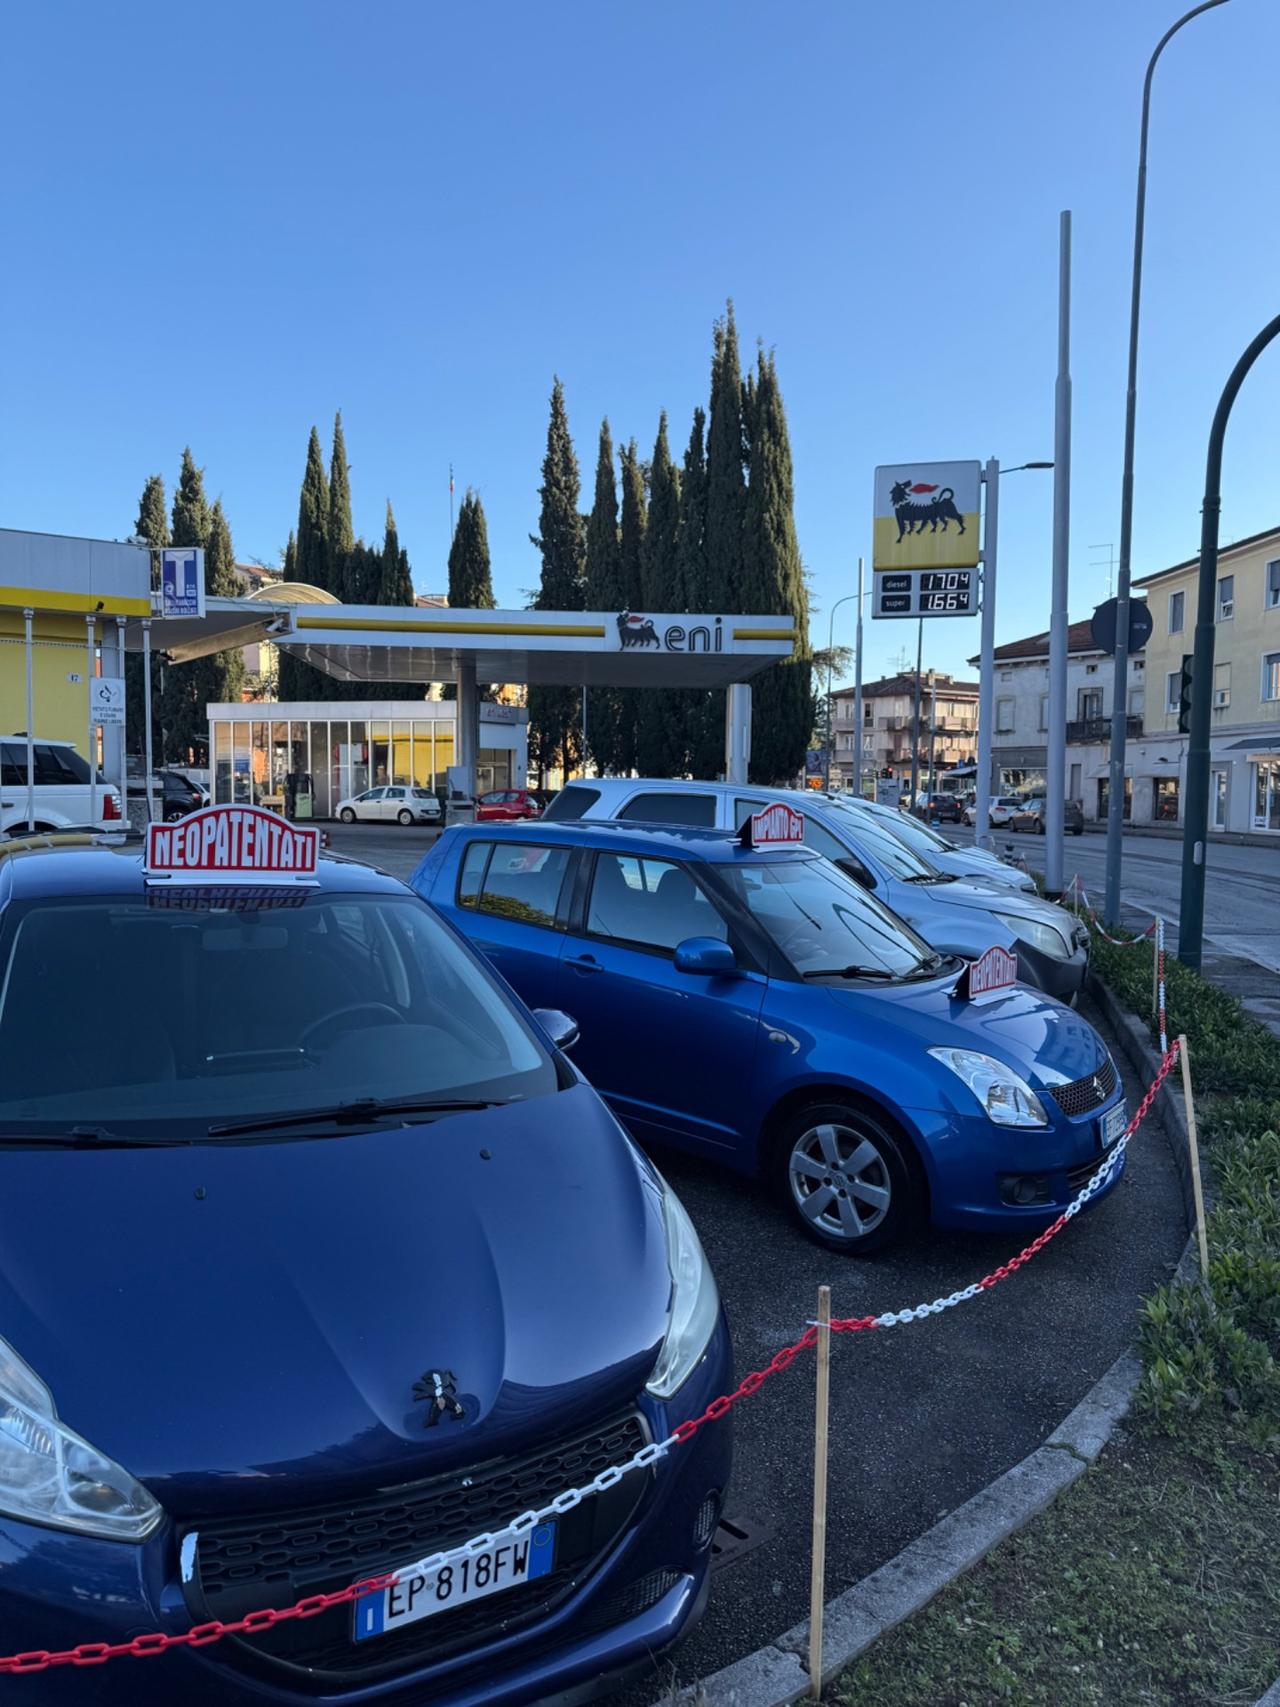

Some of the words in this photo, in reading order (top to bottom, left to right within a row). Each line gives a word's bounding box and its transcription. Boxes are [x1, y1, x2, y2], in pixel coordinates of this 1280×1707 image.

[886, 580, 907, 589] diesel
[885, 600, 905, 608] super
[665, 617, 722, 652] eni
[154, 811, 313, 868] NEOPATENTATI
[754, 807, 788, 839] IMPIANTO
[972, 948, 1015, 992] NEOPATENTATI
